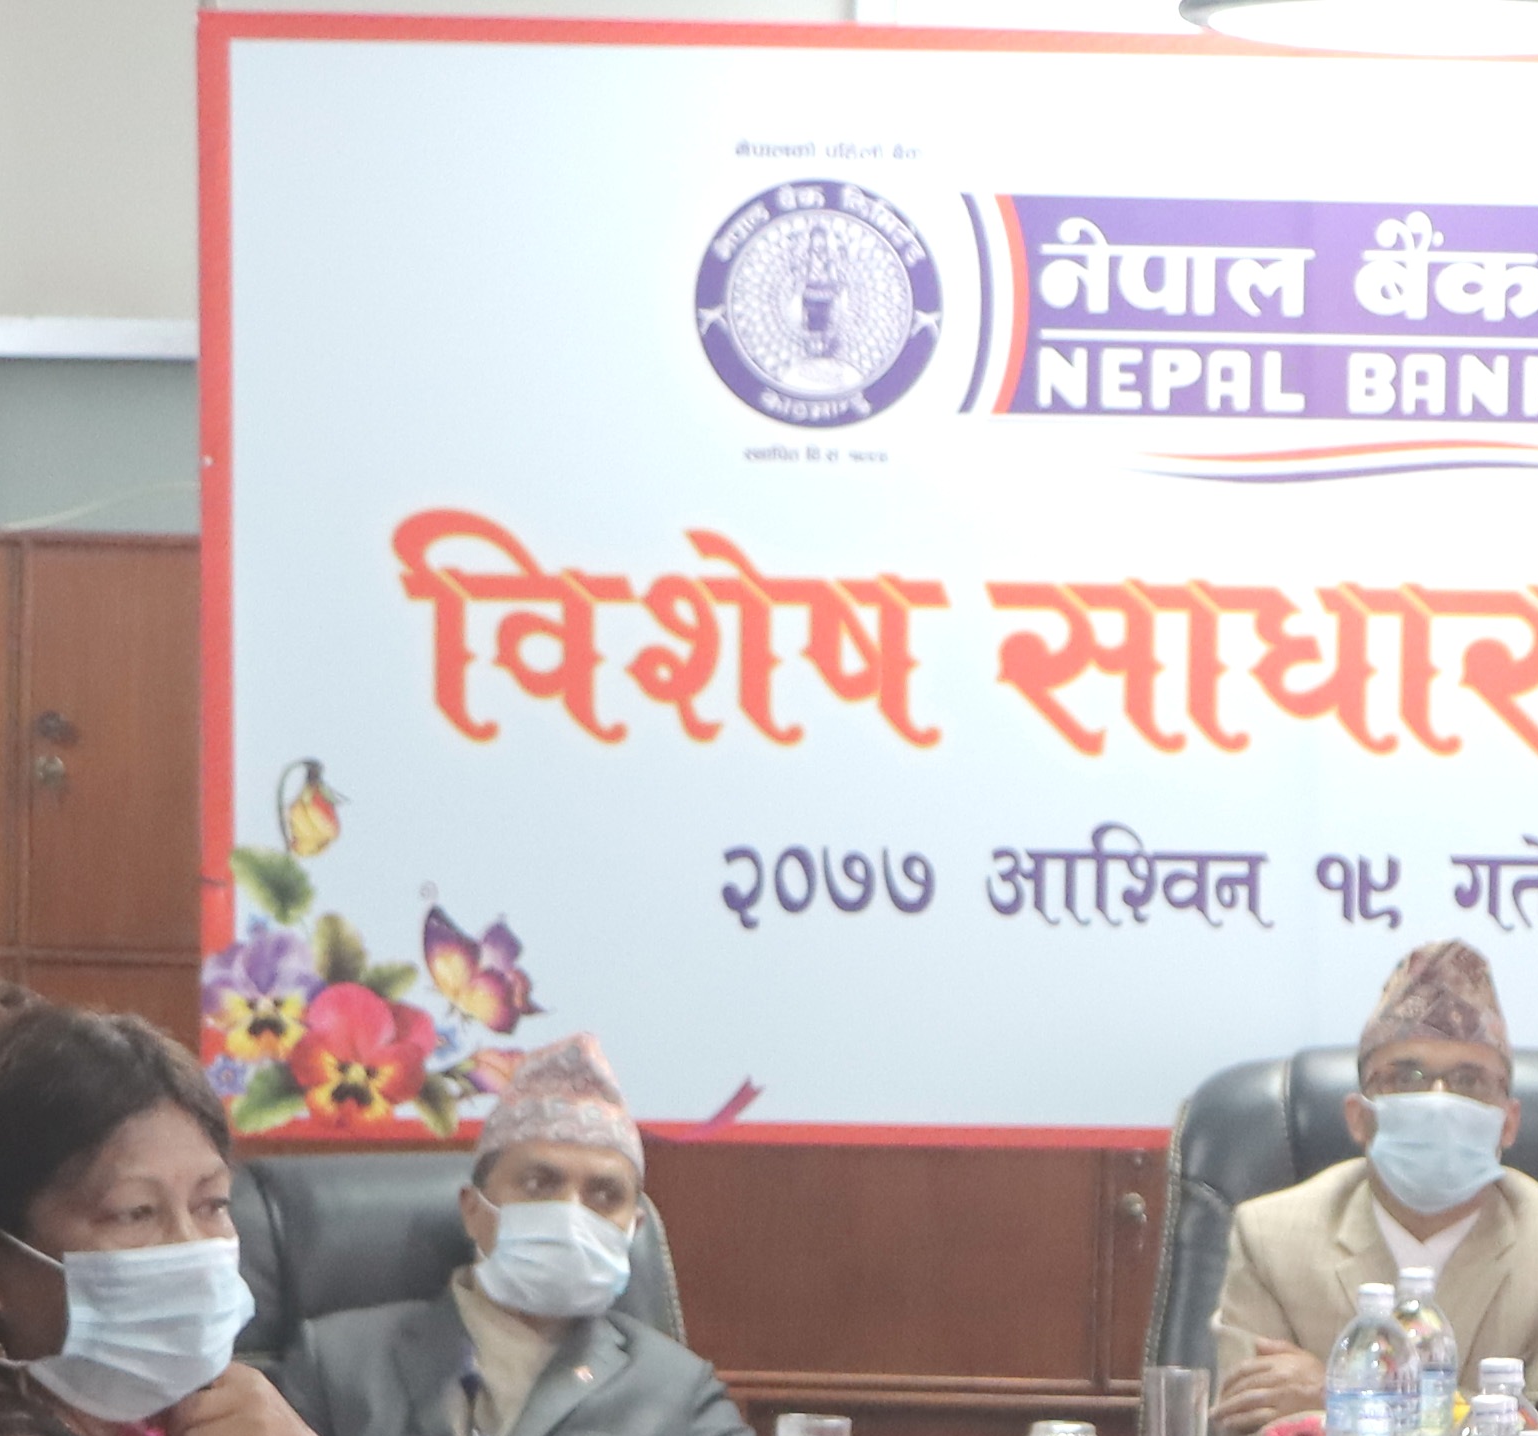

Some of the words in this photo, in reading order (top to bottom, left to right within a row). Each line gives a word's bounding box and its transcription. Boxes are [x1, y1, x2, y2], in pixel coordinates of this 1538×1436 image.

[1040, 216, 1316, 317] नेपाल
[1036, 345, 1306, 413] NEPAL
[392, 508, 951, 748] विशेष
[722, 845, 936, 929] २०७७
[986, 821, 1275, 930] आश्विन
[1316, 853, 1400, 928] १९
